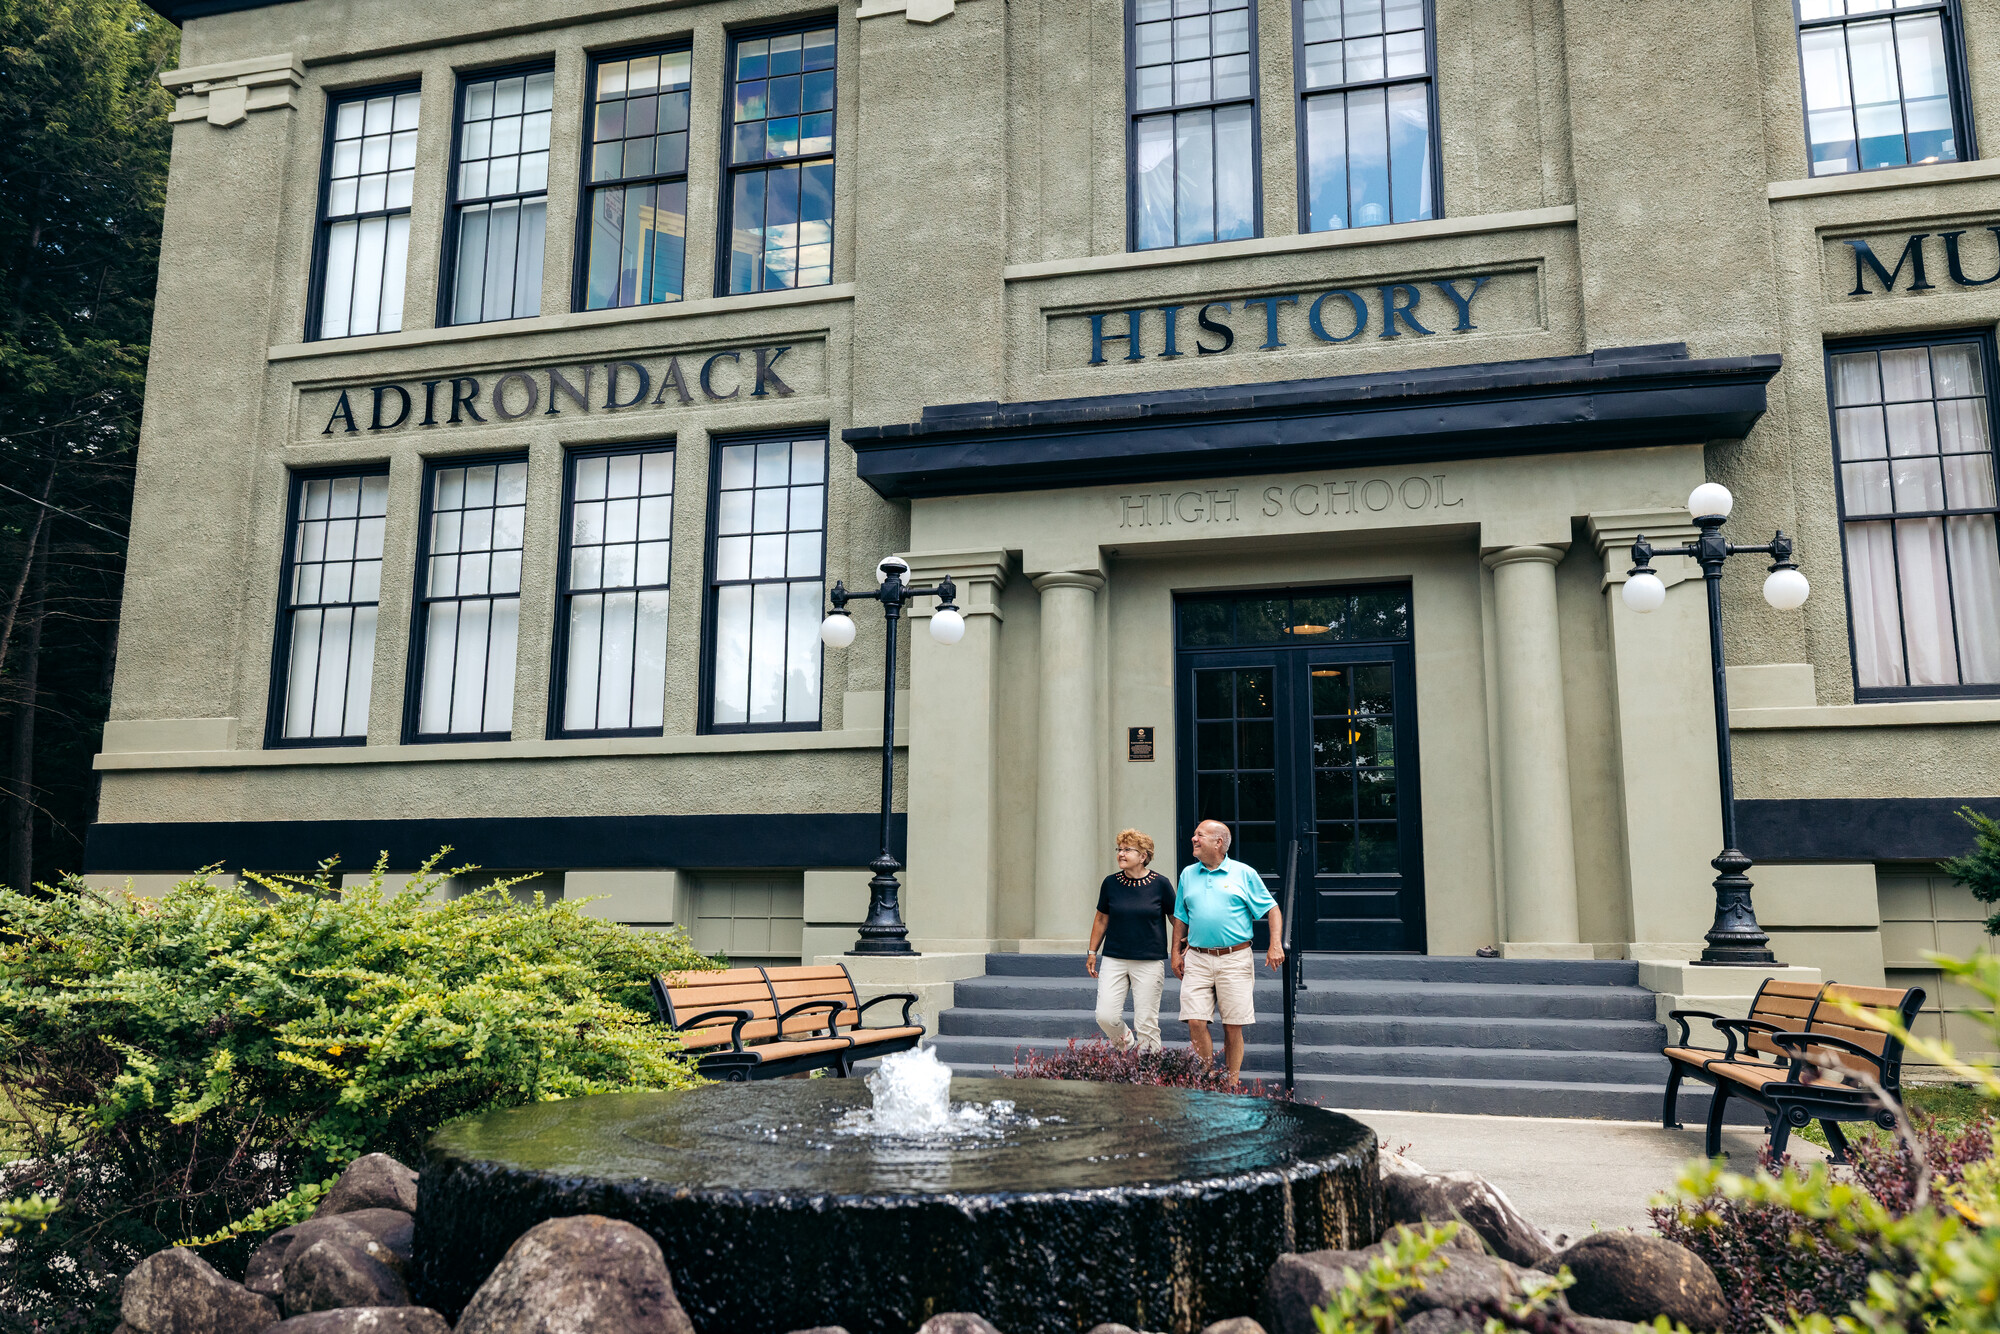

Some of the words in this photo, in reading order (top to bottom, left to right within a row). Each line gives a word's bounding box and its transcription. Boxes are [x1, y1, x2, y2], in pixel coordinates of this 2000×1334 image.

[1087, 276, 1491, 365] HISTORY
[321, 346, 796, 435] ADIRONDACK
[1119, 488, 1240, 530] HIGH
[1261, 474, 1464, 518] SCHOOL
